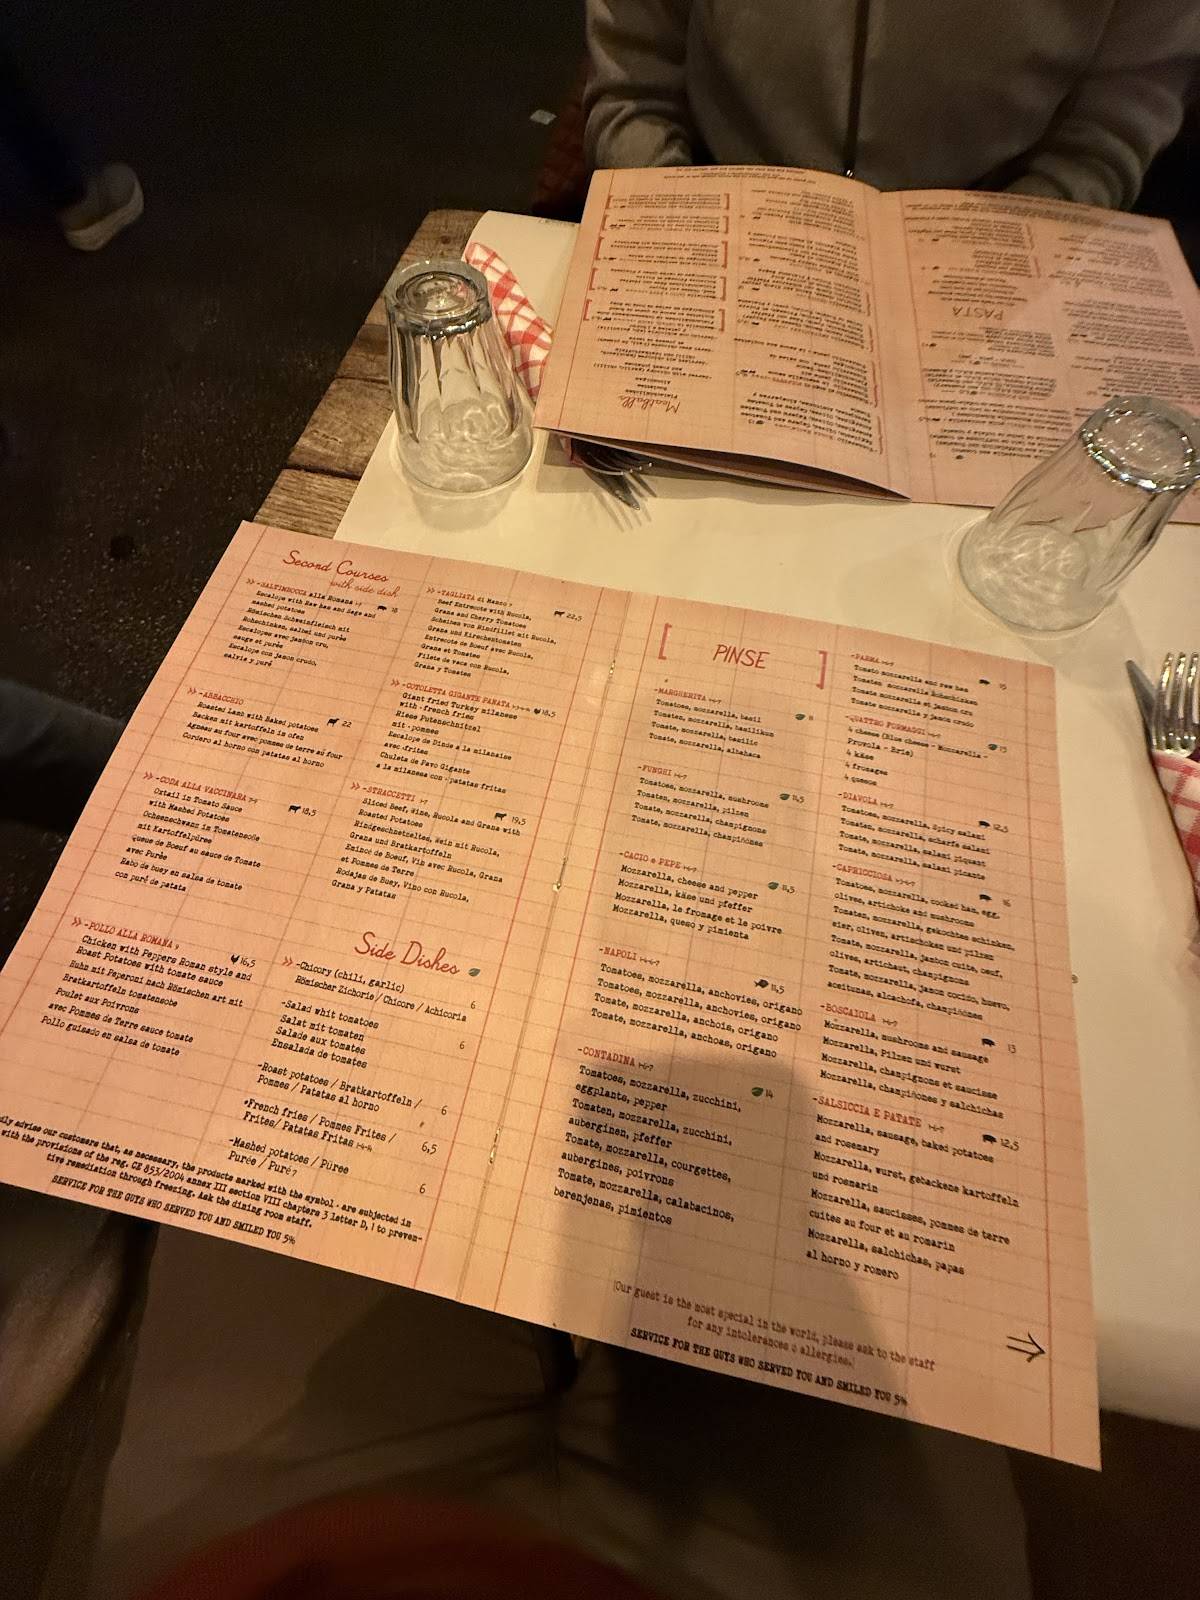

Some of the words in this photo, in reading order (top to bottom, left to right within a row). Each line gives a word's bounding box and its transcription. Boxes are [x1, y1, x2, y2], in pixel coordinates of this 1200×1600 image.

[952, 305, 1004, 320] PASTA
[282, 550, 333, 572] Second
[336, 560, 389, 582] Courses
[712, 644, 771, 670] PINSE
[447, 690, 481, 702] GIGANTE
[481, 696, 510, 708] PANATA
[341, 720, 352, 728] 22
[153, 787, 180, 799] Oxtail
[181, 794, 192, 802] in
[192, 795, 220, 808] Tomato
[220, 802, 243, 813] Sauce
[180, 781, 202, 792] ALLA
[204, 785, 247, 801] VACCINARA
[301, 806, 318, 817] 18,5
[657, 857, 681, 869] PEPE
[677, 876, 707, 889] cheese
[708, 884, 725, 893] and
[726, 887, 759, 900] pepper
[115, 927, 138, 941] ALLA
[139, 933, 174, 949] ROMANA
[81, 934, 117, 950] Chicken
[119, 945, 140, 956] with
[140, 948, 177, 964] Peppers
[178, 957, 206, 971] Roman
[207, 965, 233, 977] style
[234, 972, 252, 981] and
[240, 957, 256, 968] 16,5
[354, 931, 396, 962] Side
[400, 940, 461, 976] Dishes
[75, 945, 102, 959] Roast
[102, 951, 142, 968] Potatoes
[144, 962, 165, 974] with
[166, 966, 196, 981] tomate
[197, 975, 223, 987] sauce
[367, 978, 405, 994] garlic)
[55, 987, 83, 1001] Poulet
[83, 995, 100, 1005] aux
[100, 998, 140, 1014] Poivrons
[294, 974, 337, 992] Römischer
[337, 984, 375, 1001] Zichorie
[382, 994, 415, 1010] Chicore
[424, 1004, 467, 1022] Achicoria
[470, 1000, 476, 1010] 6
[762, 1001, 803, 1016] origano
[279, 1014, 307, 1028] Salat
[308, 1022, 326, 1032] mit
[327, 1025, 365, 1042] tomaten
[314, 1007, 336, 1019] whit
[338, 1012, 379, 1029] tomatoes
[275, 1026, 308, 1041] Salade
[309, 1035, 328, 1046] aux
[329, 1038, 366, 1055] tomates
[459, 1041, 465, 1050] 6
[270, 1037, 315, 1056] Ensalada
[316, 1048, 328, 1059] de
[330, 1052, 368, 1069] tomates
[256, 1073, 290, 1090] Pommes
[299, 1084, 337, 1102] Patatas
[338, 1094, 349, 1105] al
[351, 1096, 380, 1112] horno
[288, 1071, 329, 1087] potatoes
[338, 1080, 412, 1107] Bratkartoffeln
[441, 1105, 448, 1116] 6
[632, 1097, 668, 1111] pepper
[242, 1110, 282, 1129] Frites/
[281, 1120, 319, 1139] Patatas
[320, 1130, 354, 1147] Fritas
[280, 1107, 308, 1122] fries
[318, 1115, 352, 1132] Pommes
[353, 1124, 387, 1141] Frites
[873, 1107, 880, 1118] E
[883, 1110, 922, 1128] PATATE
[266, 1147, 310, 1164] potatoes
[421, 1141, 437, 1155] 6,5
[814, 1133, 832, 1144] and
[834, 1138, 880, 1156] rosemary
[625, 1167, 674, 1187] poivrons
[419, 1183, 426, 1194] 6
[51, 1175, 88, 1191] SERVICE
[87, 1183, 105, 1195] FOR
[105, 1188, 124, 1200] THE
[124, 1193, 146, 1205] GUYS
[162, 1203, 196, 1218] SERVED
[196, 1211, 214, 1222] YOU
[213, 1215, 232, 1227] AND
[232, 1220, 265, 1236] SMILED
[265, 1228, 282, 1241] YOU
[282, 1233, 295, 1245] 5%
[616, 1203, 672, 1225] pimientos
[806, 1250, 818, 1260] al
[820, 1252, 851, 1268] horno
[853, 1261, 861, 1272] y
[863, 1264, 899, 1280] romero
